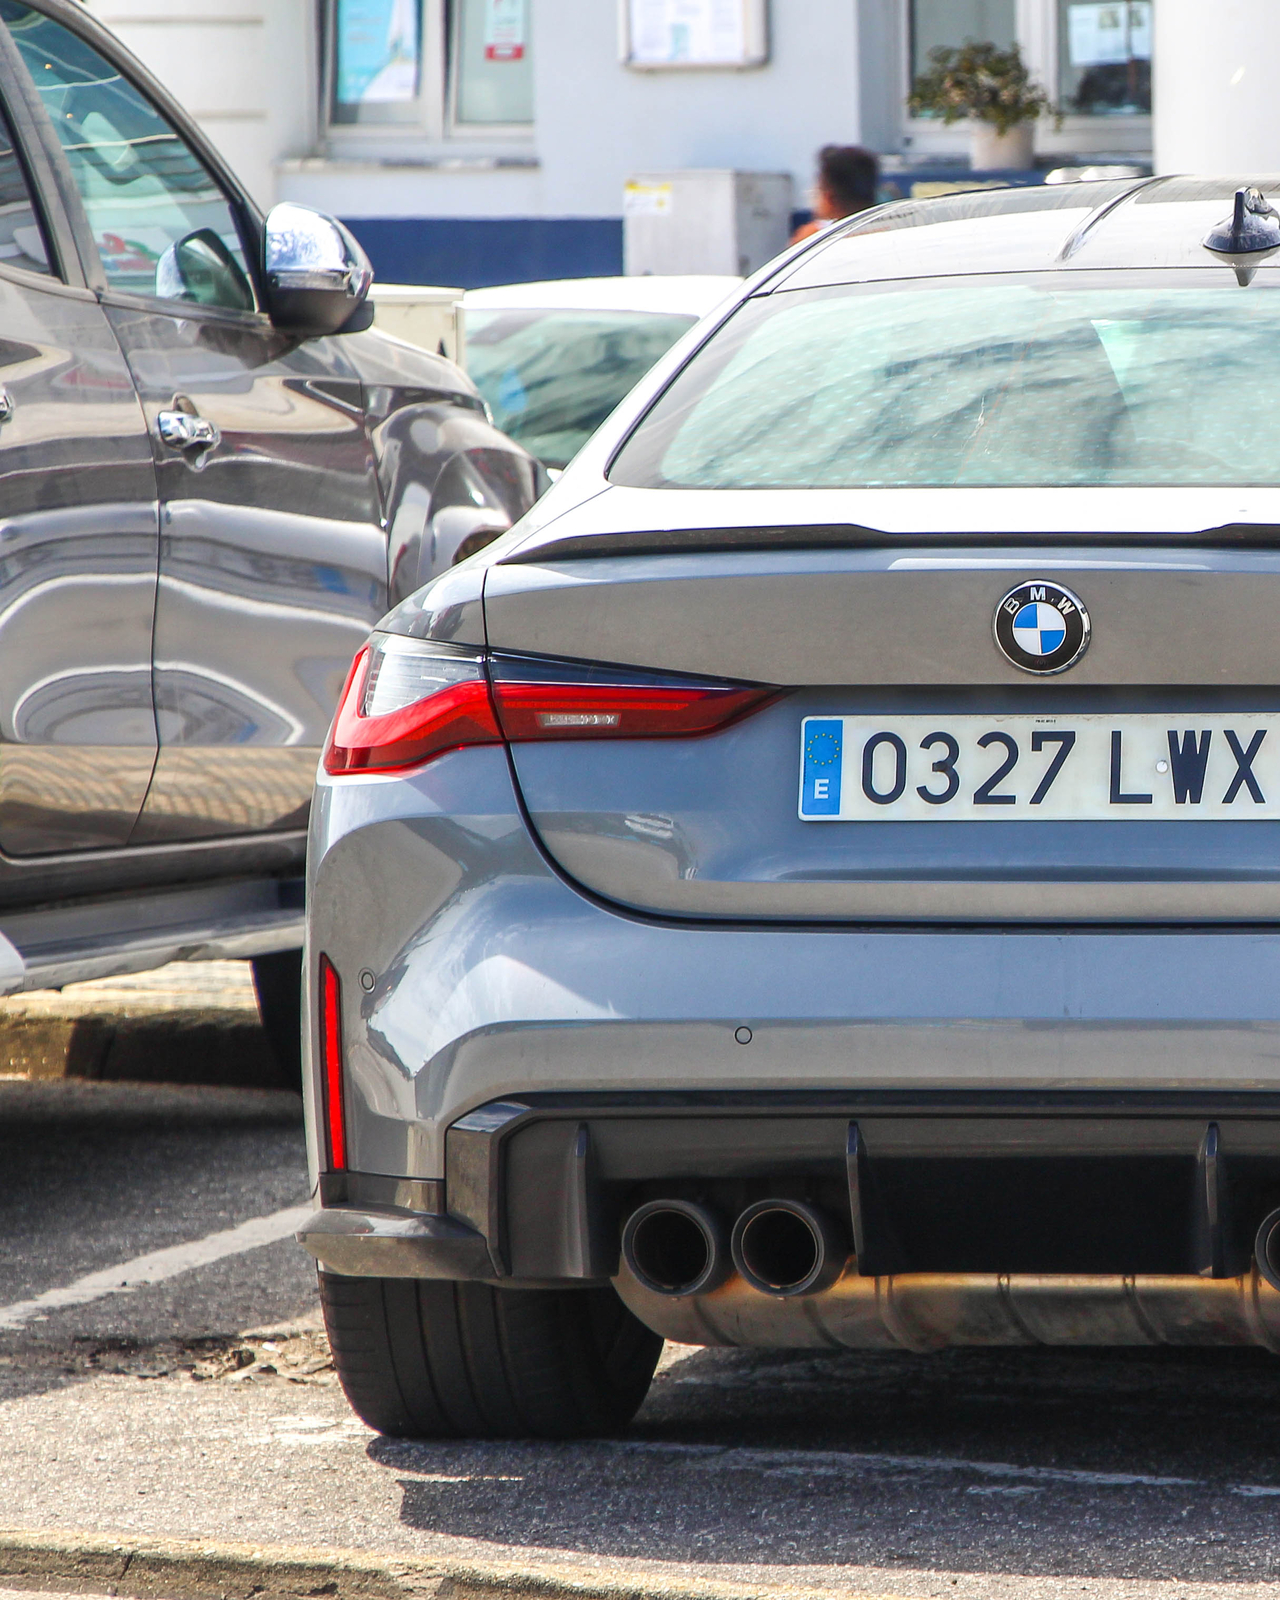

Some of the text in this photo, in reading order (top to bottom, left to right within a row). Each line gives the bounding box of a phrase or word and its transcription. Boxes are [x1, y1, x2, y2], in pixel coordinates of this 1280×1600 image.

[1003, 587, 1076, 615] BMW
[861, 730, 1268, 805] 0327 LWX
[814, 778, 829, 799] E
